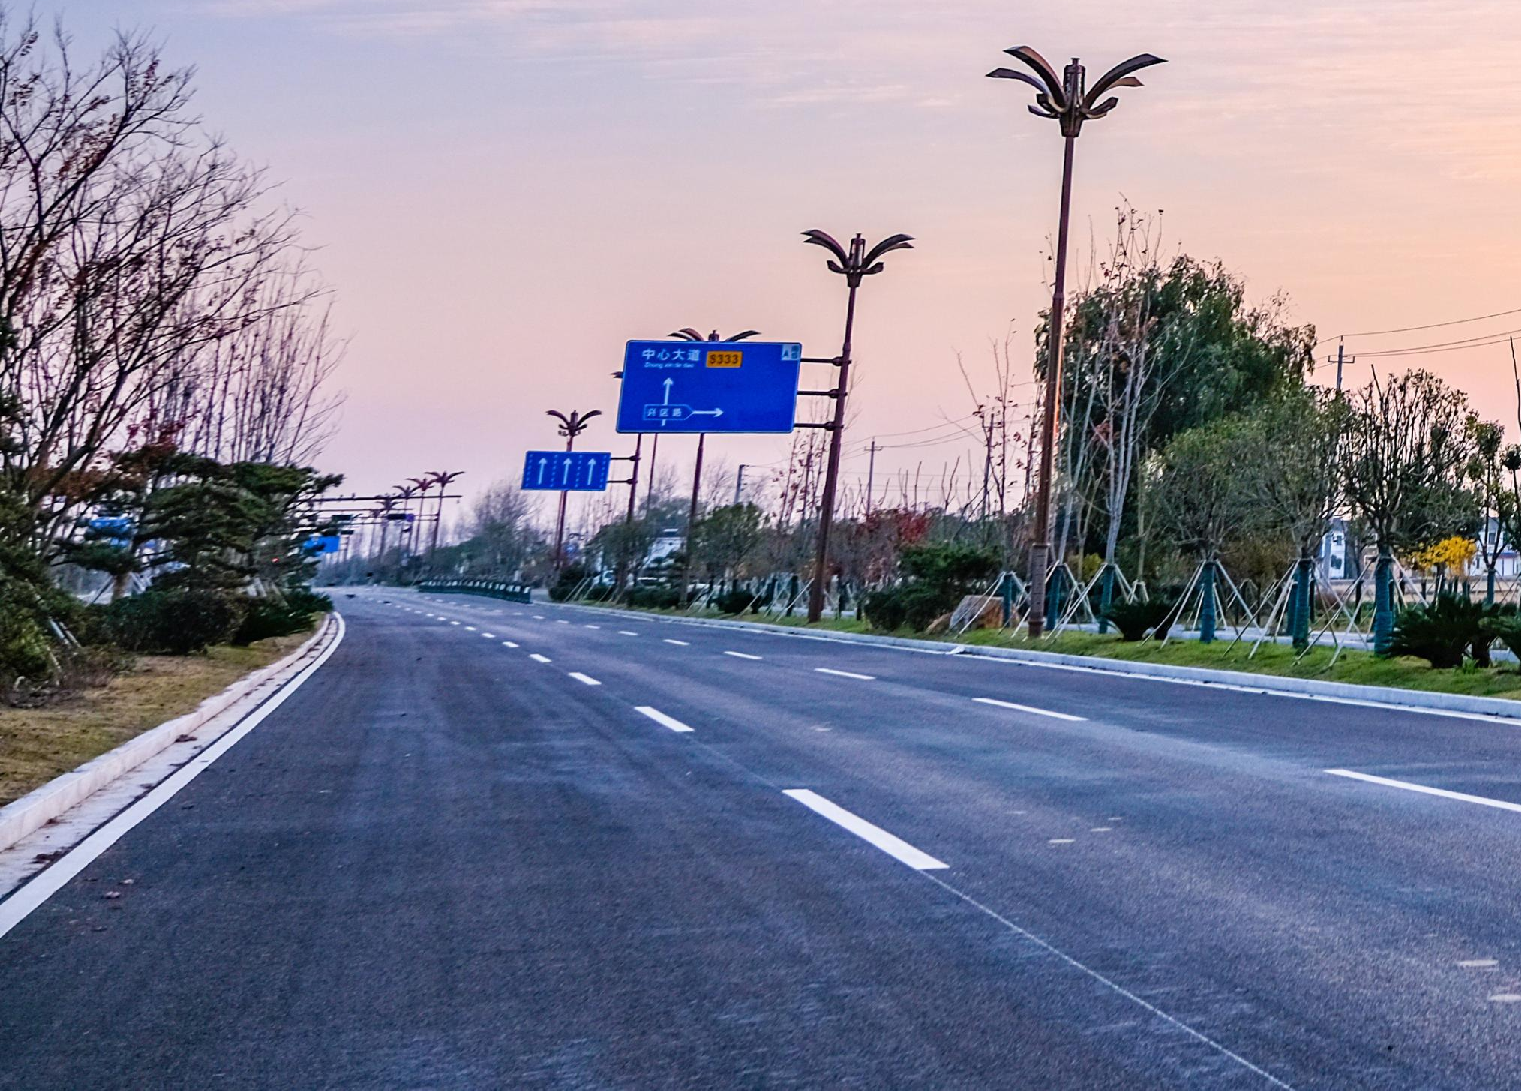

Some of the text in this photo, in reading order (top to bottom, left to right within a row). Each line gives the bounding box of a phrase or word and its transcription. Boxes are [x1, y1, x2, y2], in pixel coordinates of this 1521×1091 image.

[642, 348, 701, 361] 中心大道
[709, 354, 739, 364] S333
